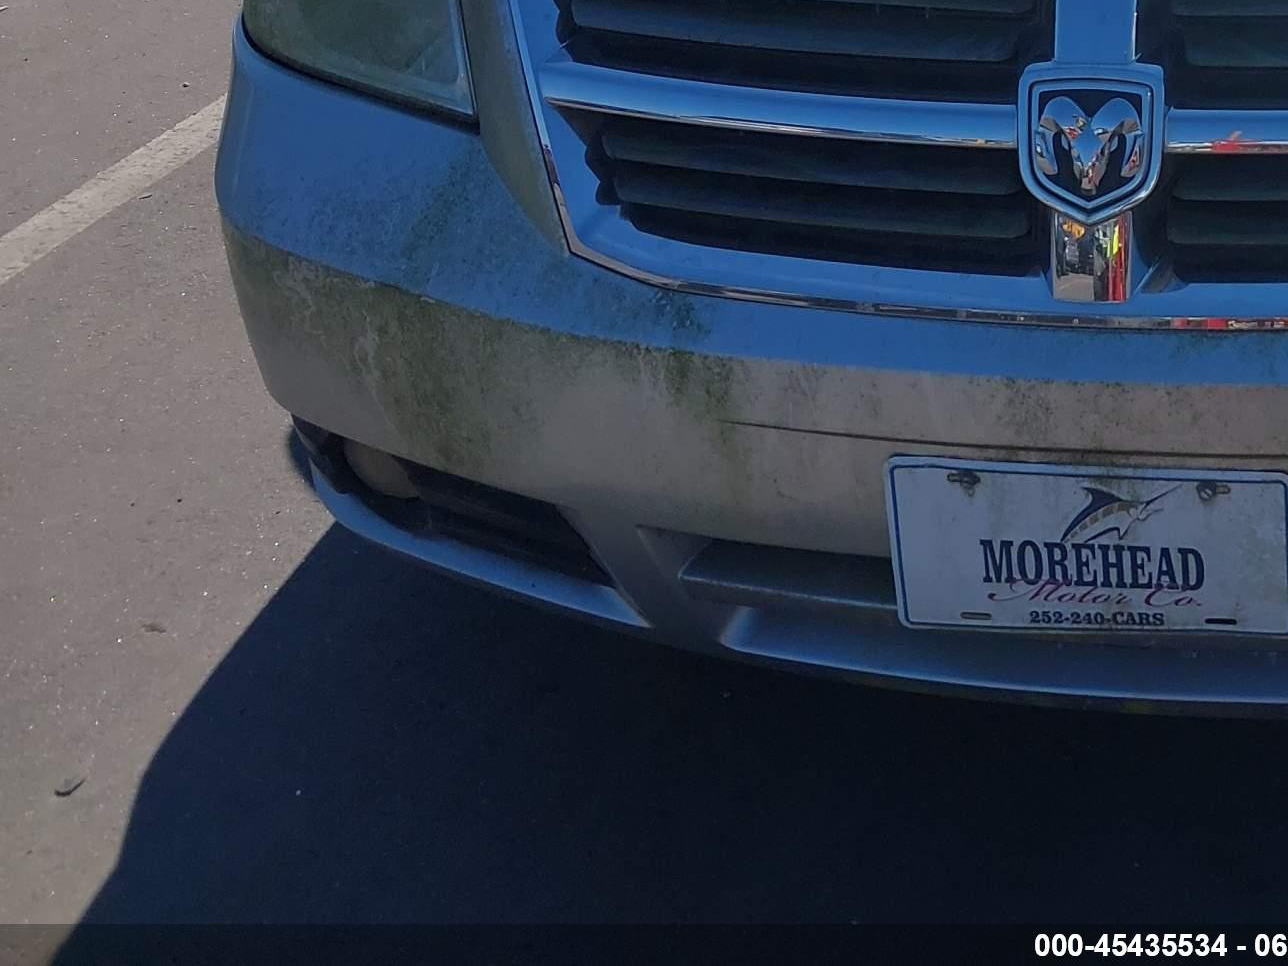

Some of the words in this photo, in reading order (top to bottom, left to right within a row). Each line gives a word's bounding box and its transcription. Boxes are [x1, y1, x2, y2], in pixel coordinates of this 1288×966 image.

[979, 538, 1205, 591] MOREHEAD
[987, 578, 1133, 606] Motor
[1145, 584, 1203, 608] Co.
[1029, 610, 1165, 627] 252-240-CARS
